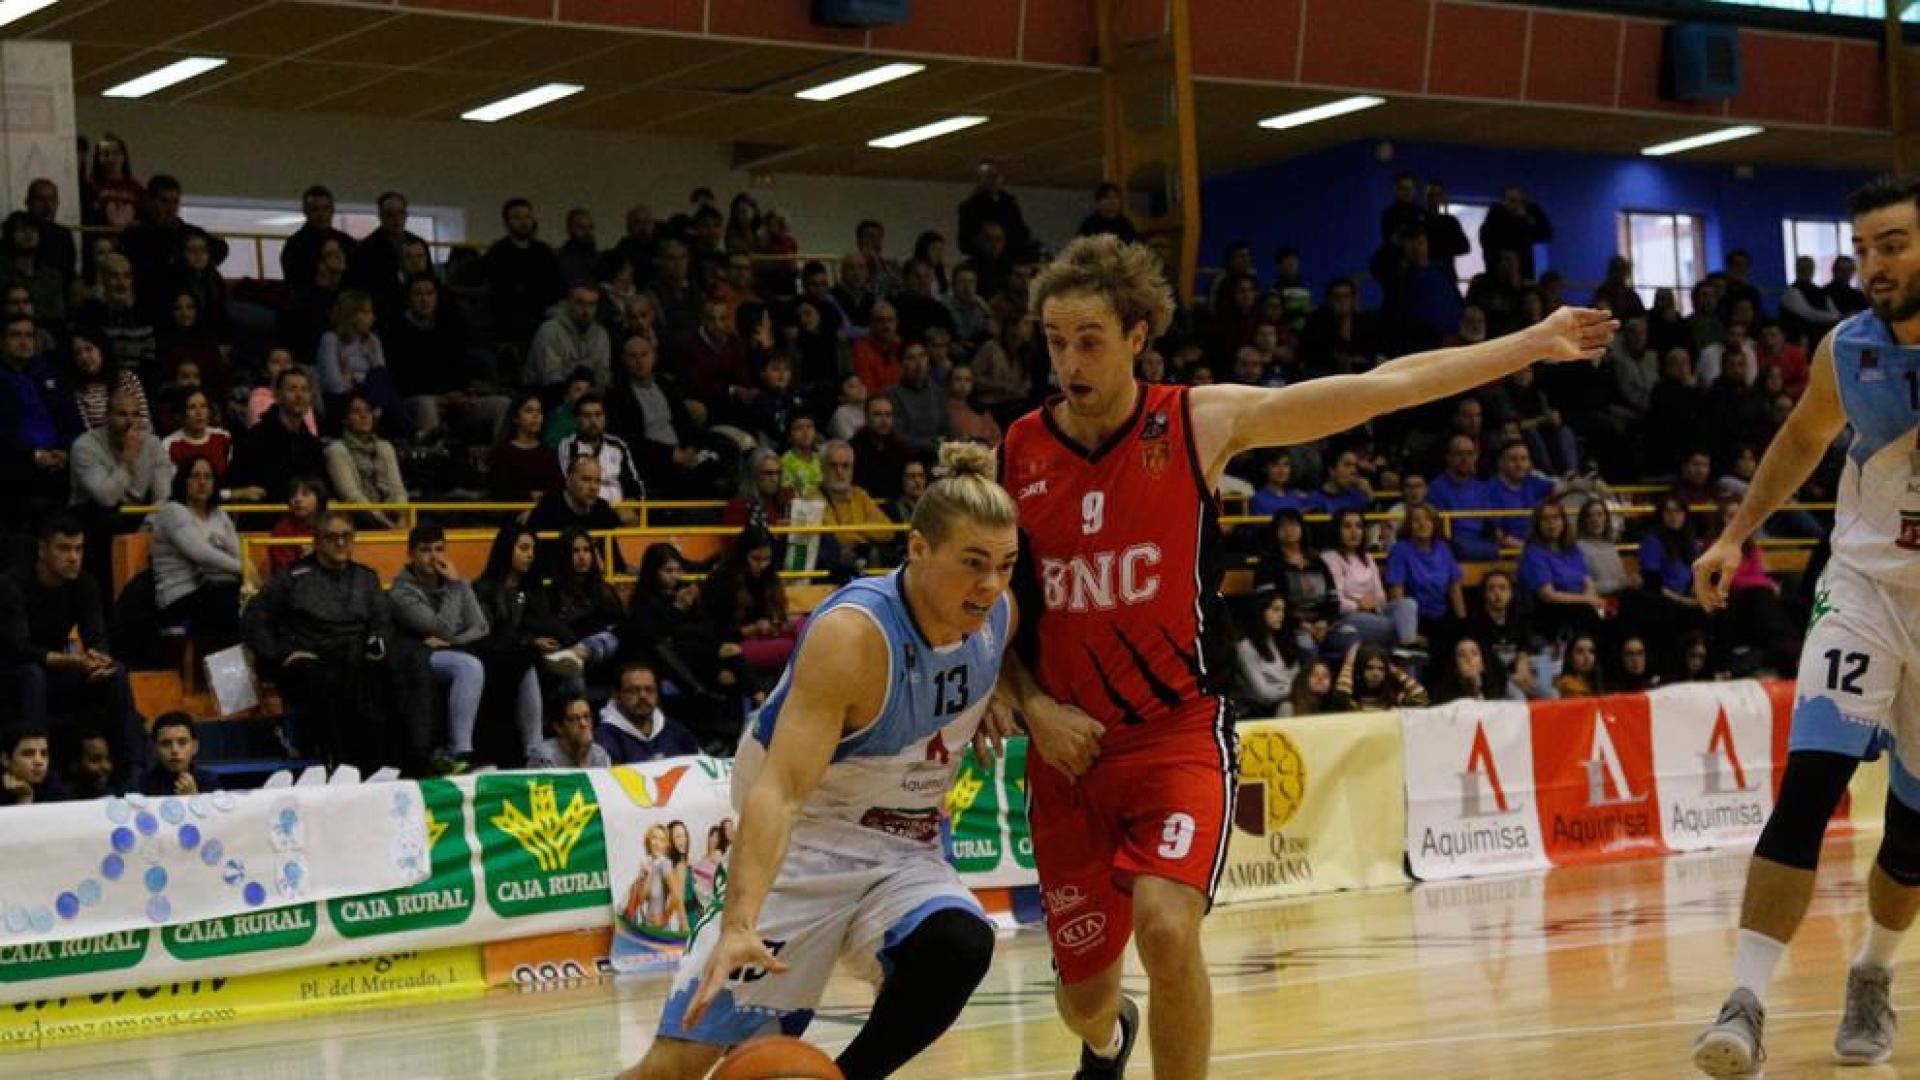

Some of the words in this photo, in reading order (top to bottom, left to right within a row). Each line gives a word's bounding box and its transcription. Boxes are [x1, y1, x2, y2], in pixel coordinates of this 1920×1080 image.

[1081, 490, 1106, 536] 9
[1041, 542, 1162, 612] BNC
[1824, 648, 1871, 695] 12
[933, 664, 969, 717] 13
[1157, 812, 1196, 860] 9
[1553, 812, 1649, 846] Aquimisa
[1671, 798, 1763, 839] Aquimisa
[952, 838, 997, 859] URAL
[1421, 821, 1529, 862] Aquimisa
[498, 878, 546, 902] CAJA
[1226, 858, 1313, 889] AMORANO
[341, 898, 393, 922] CAJA
[398, 889, 468, 916] RURAL
[174, 918, 228, 943] CAJA
[232, 908, 311, 937] RURAL
[1062, 918, 1102, 944] KIA
[330, 976, 356, 997] del
